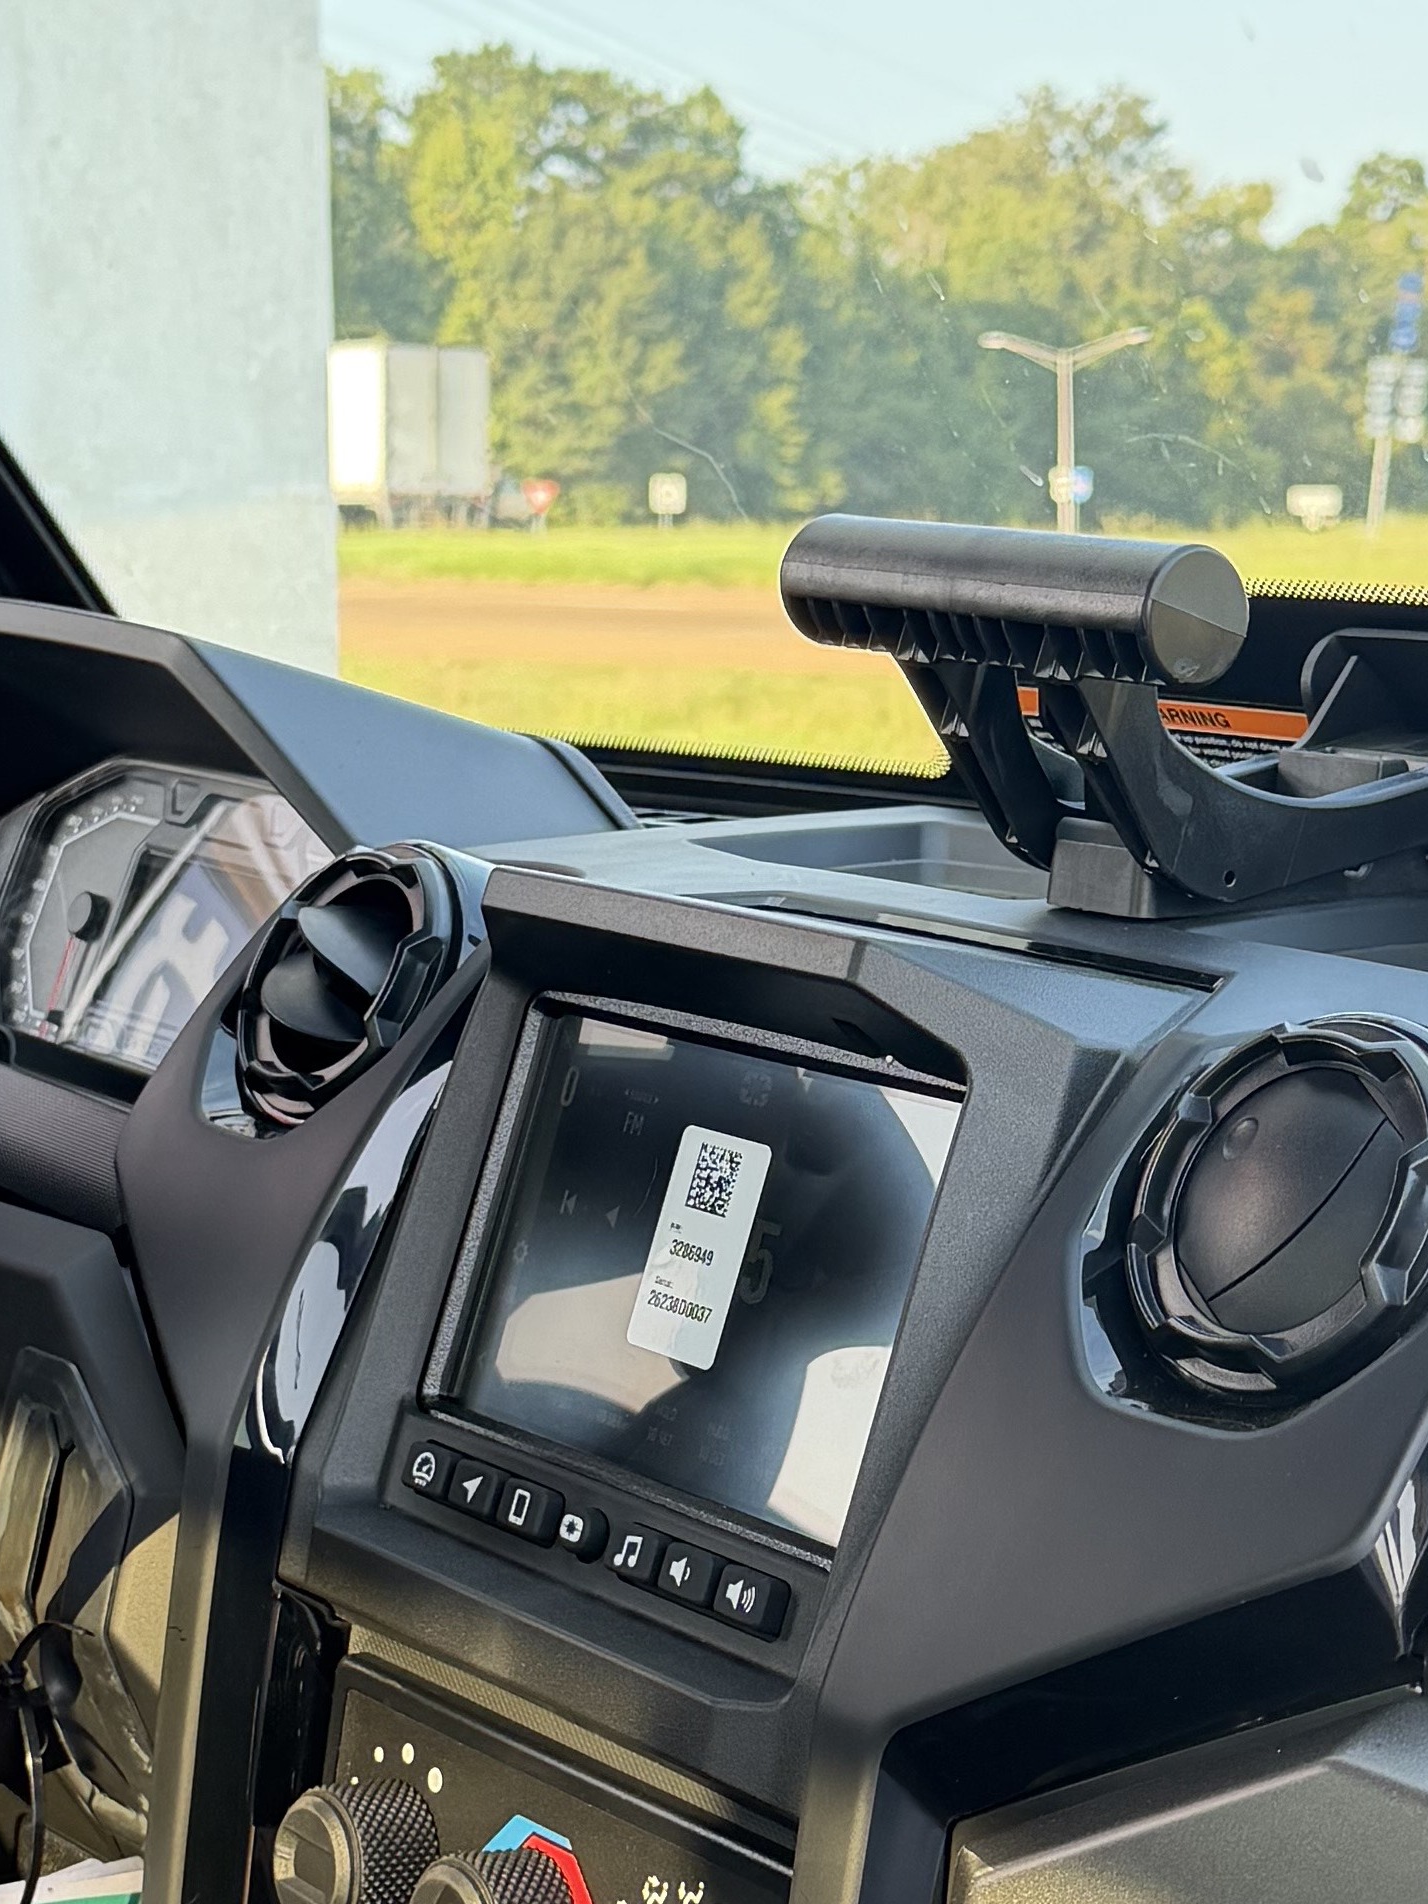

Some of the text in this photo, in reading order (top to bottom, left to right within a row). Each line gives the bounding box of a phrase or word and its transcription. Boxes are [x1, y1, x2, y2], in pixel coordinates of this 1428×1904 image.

[1159, 708, 1231, 729] ARNING
[623, 1111, 645, 1136] FM
[669, 1238, 714, 1266] 3286949
